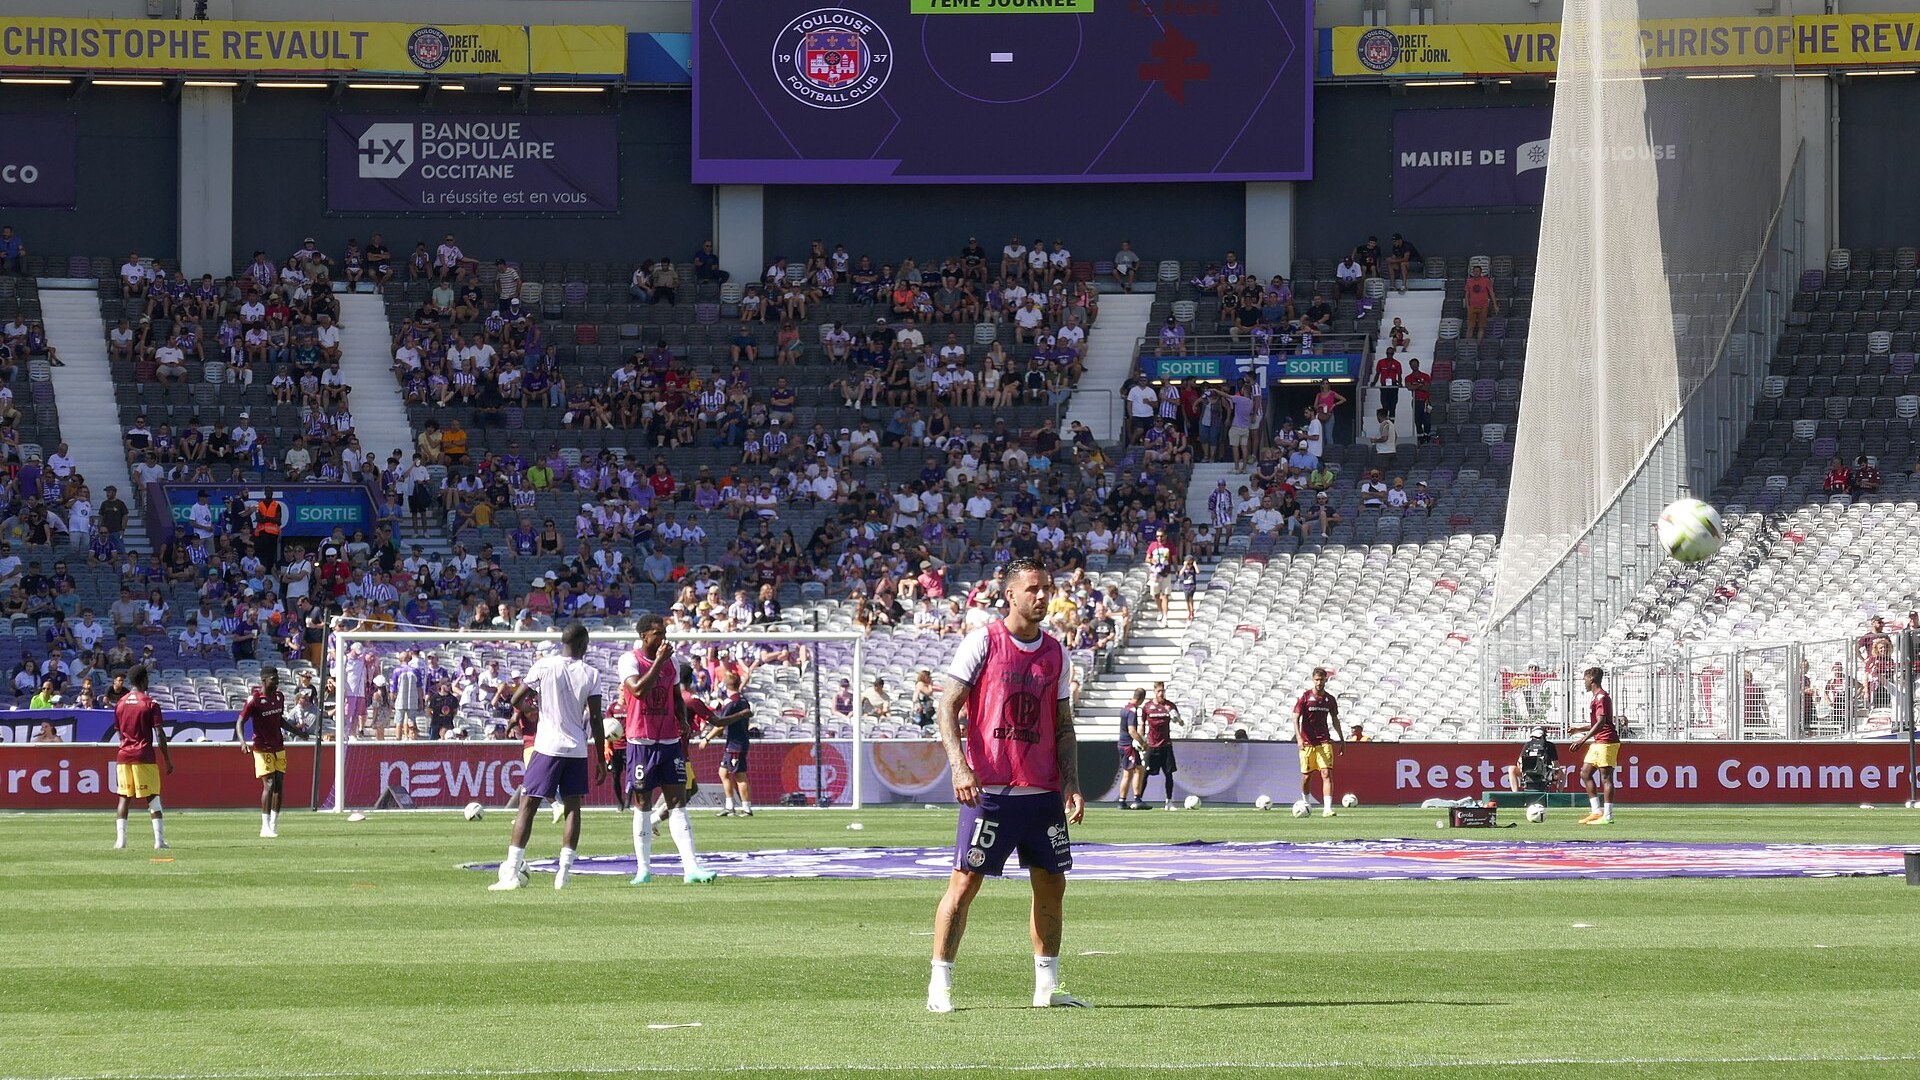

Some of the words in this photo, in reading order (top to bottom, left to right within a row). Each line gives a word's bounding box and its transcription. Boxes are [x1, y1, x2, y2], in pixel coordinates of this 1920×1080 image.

[793, 14, 872, 35] TOULOUSE
[3, 26, 211, 59] CHRISTOPHE
[222, 30, 370, 60] REVAULT
[1634, 25, 1839, 59] CHRISTOPHE
[471, 50, 502, 63] JORN.
[778, 54, 791, 63] 19
[872, 54, 888, 63] 37
[1420, 49, 1451, 63] JORN.
[787, 75, 848, 103] FOOTBALL
[849, 75, 879, 98] CLUB
[421, 122, 521, 140] BANQUE
[421, 142, 555, 160] POPULAIRE
[1401, 151, 1472, 167] MAIRIE
[1479, 150, 1505, 165] DE
[421, 164, 514, 179] OCCITANE
[422, 190, 435, 203] la
[440, 189, 498, 203] réussite
[503, 192, 525, 203] est
[530, 193, 549, 203] en
[553, 192, 587, 203] vous
[1161, 362, 1215, 374] SORTIE
[1289, 361, 1344, 373] SORTIE
[300, 507, 357, 521] SORTIE
[0, 759, 120, 794] rcial
[379, 760, 527, 797] newre
[634, 764, 645, 780] 6
[970, 818, 999, 848] 15
